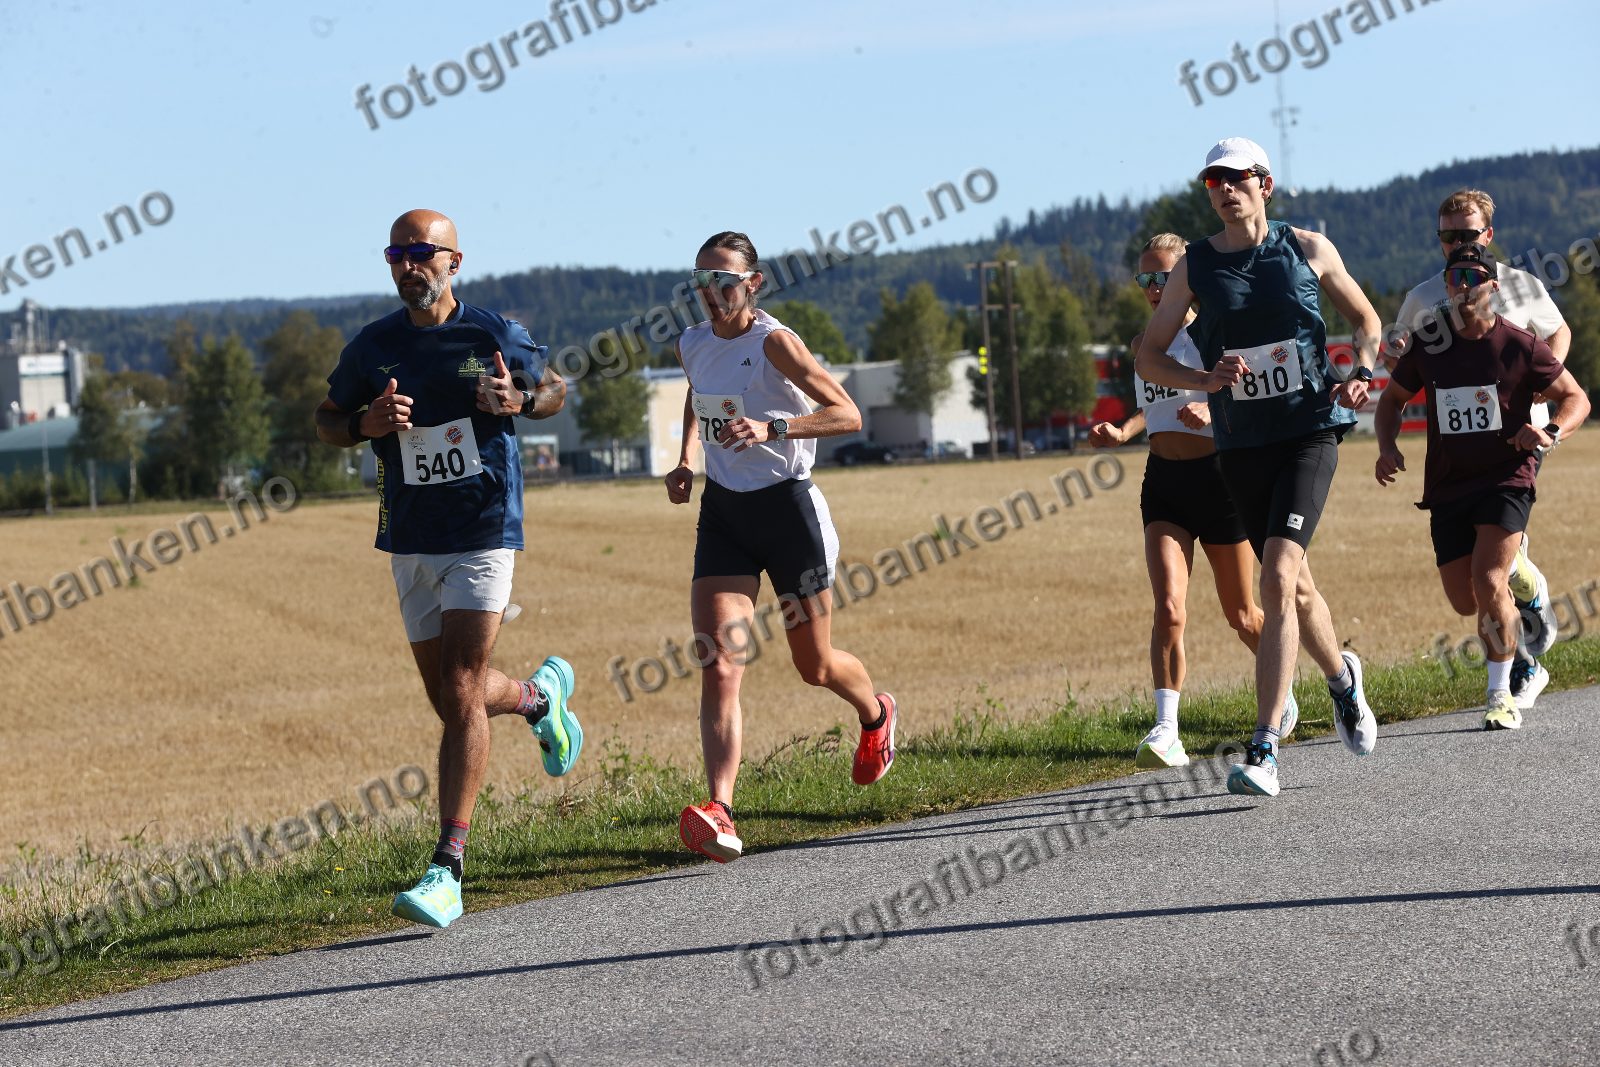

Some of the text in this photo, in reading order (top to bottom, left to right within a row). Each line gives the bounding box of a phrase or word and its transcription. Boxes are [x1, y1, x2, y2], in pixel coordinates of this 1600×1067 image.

[1243, 366, 1289, 398] 810
[1448, 406, 1490, 432] 813
[415, 447, 466, 483] 540
